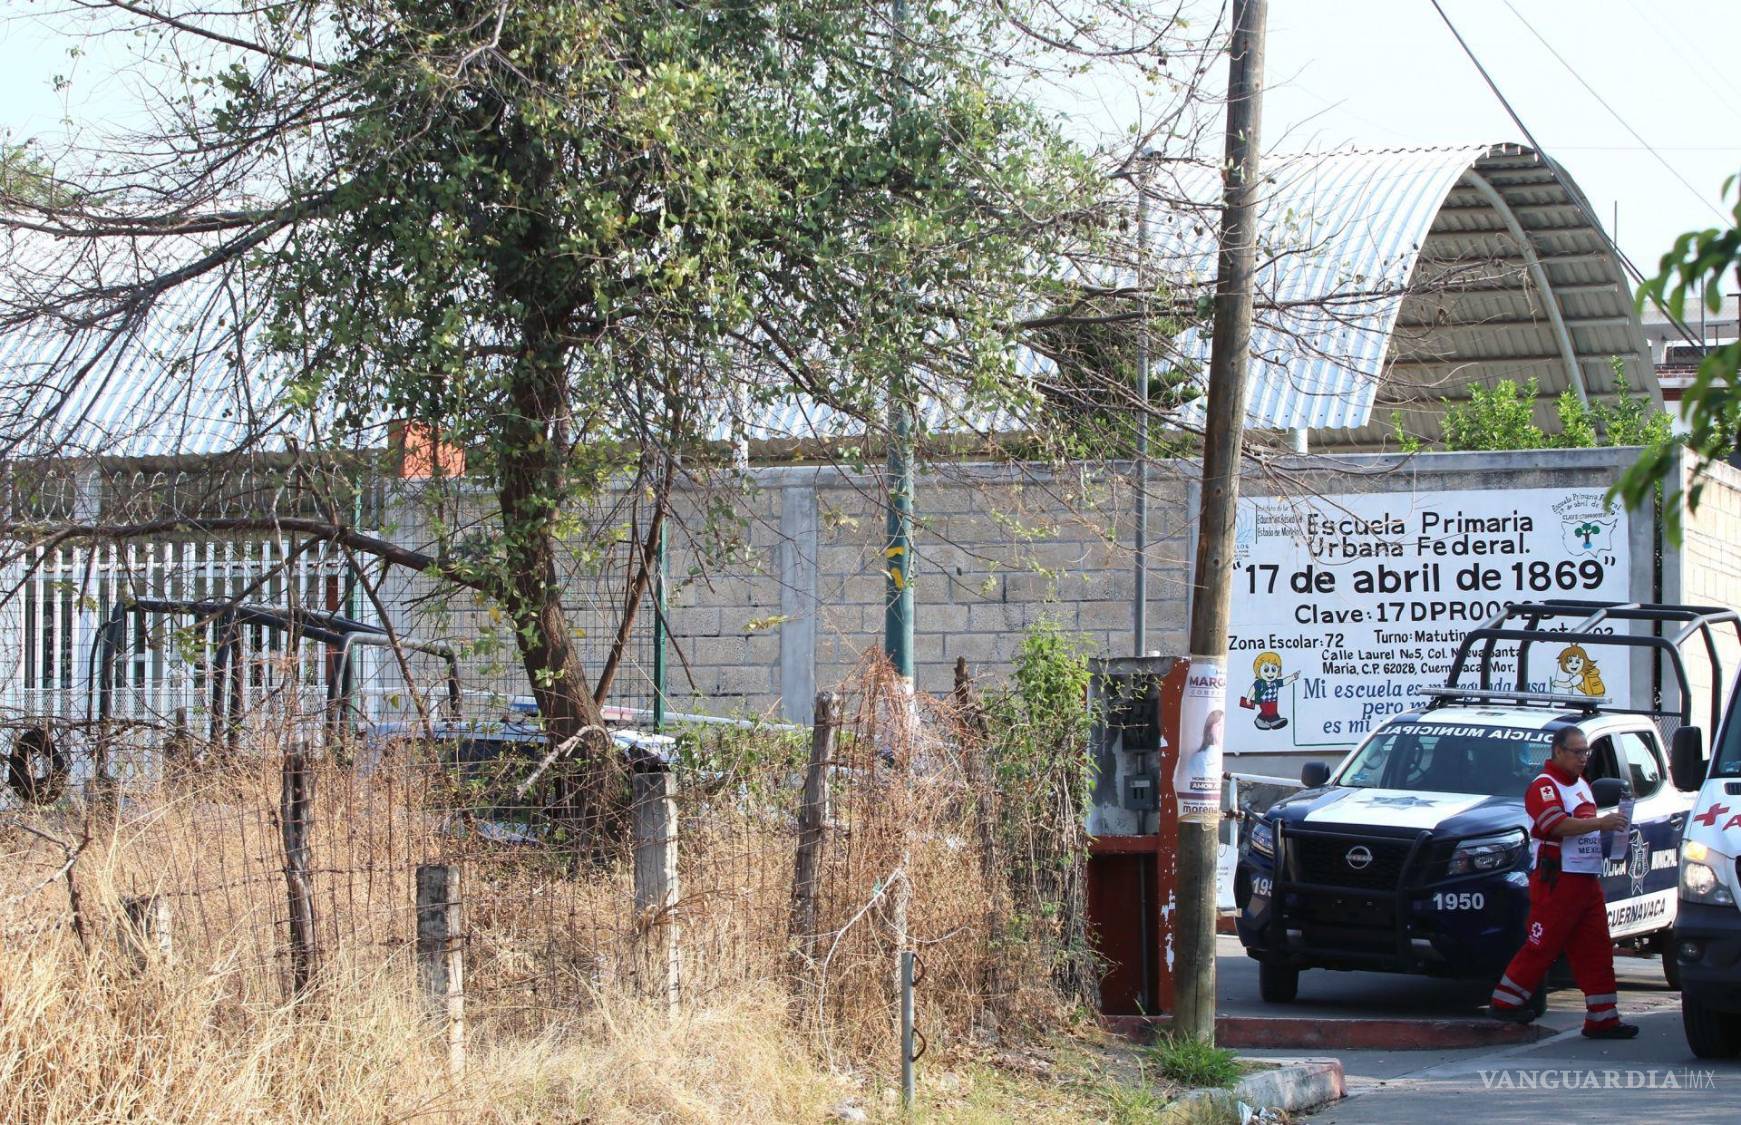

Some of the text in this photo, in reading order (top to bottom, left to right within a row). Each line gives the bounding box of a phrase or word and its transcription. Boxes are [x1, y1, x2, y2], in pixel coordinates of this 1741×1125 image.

[1307, 512, 1405, 536] Escuela
[1422, 510, 1533, 533] Primaria
[1309, 533, 1530, 557] Urbana Federal.
[1290, 564, 1335, 594] de
[1353, 563, 1440, 593] abril
[1456, 562, 1501, 591] de
[1228, 635, 1265, 650] Zona
[1322, 649, 1353, 661] Calle
[1358, 650, 1395, 661] Laurel
[1428, 648, 1448, 659] Col.
[1451, 648, 1482, 659] Neva
[1323, 662, 1359, 676] Maria,
[1362, 663, 1379, 675] C.P.
[1383, 662, 1418, 676] 62028,
[1490, 661, 1516, 673] Mor.
[1303, 678, 1326, 699] Mi
[1335, 680, 1402, 698] escuela
[1362, 702, 1403, 720] pero
[1323, 715, 1371, 734] es mi
[1432, 893, 1485, 911] 1950
